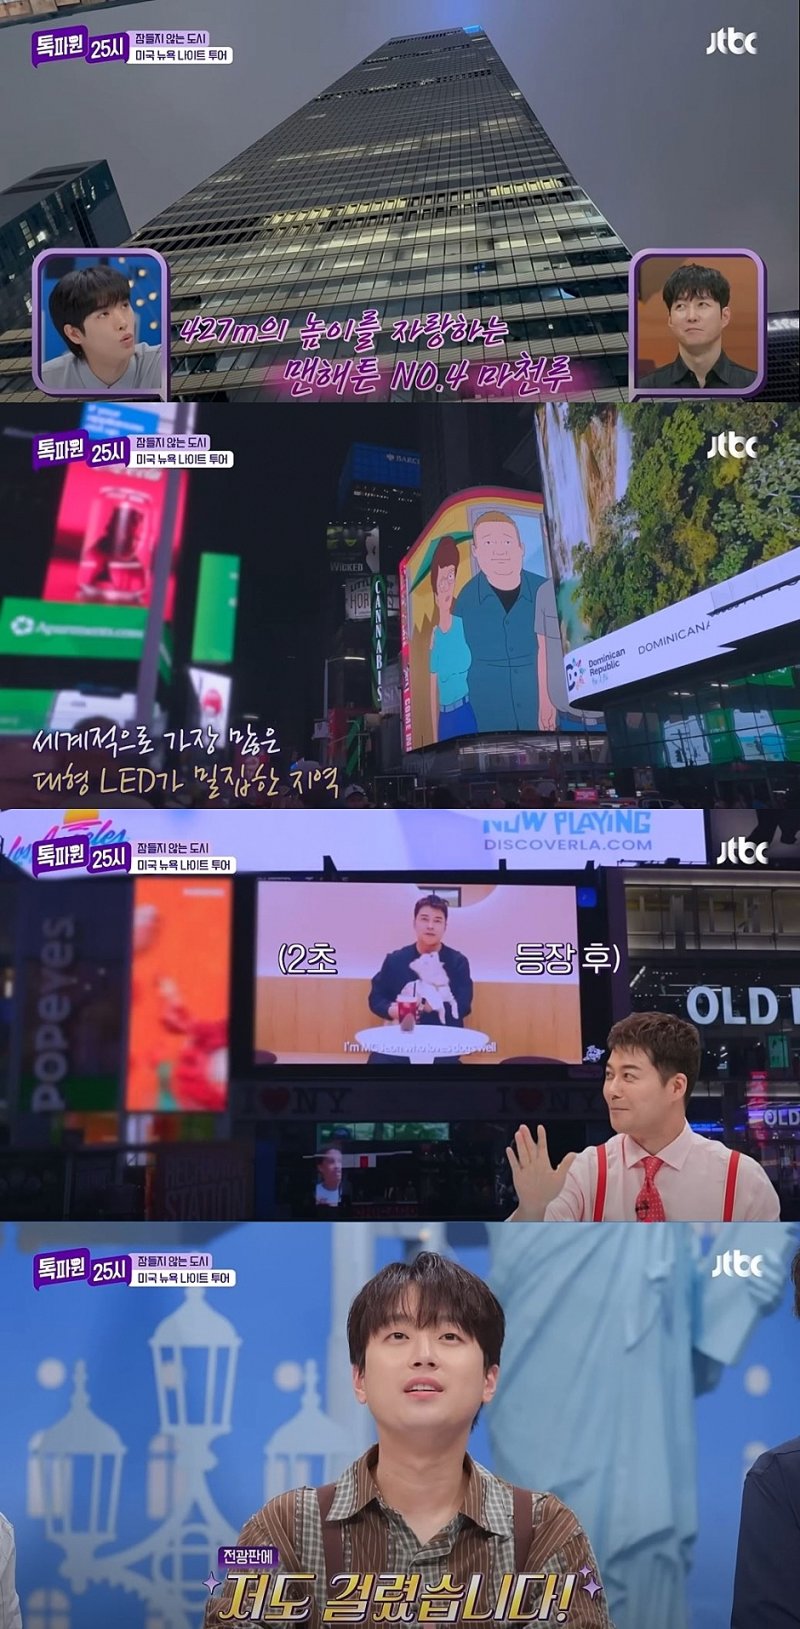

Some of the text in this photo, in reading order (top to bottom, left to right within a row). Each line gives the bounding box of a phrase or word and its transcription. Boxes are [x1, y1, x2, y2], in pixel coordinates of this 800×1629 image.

[374, 580, 383, 702] CANNABIS
[588, 648, 626, 668] Dominican
[589, 660, 620, 677] Republic
[554, 810, 652, 835] PLAYING
[484, 839, 653, 850] DISCOVERLA.COM
[686, 985, 778, 1025] OLD
[344, 1041, 360, 1052] I'm
[477, 1041, 497, 1053] well
[764, 1109, 800, 1127] OLD
